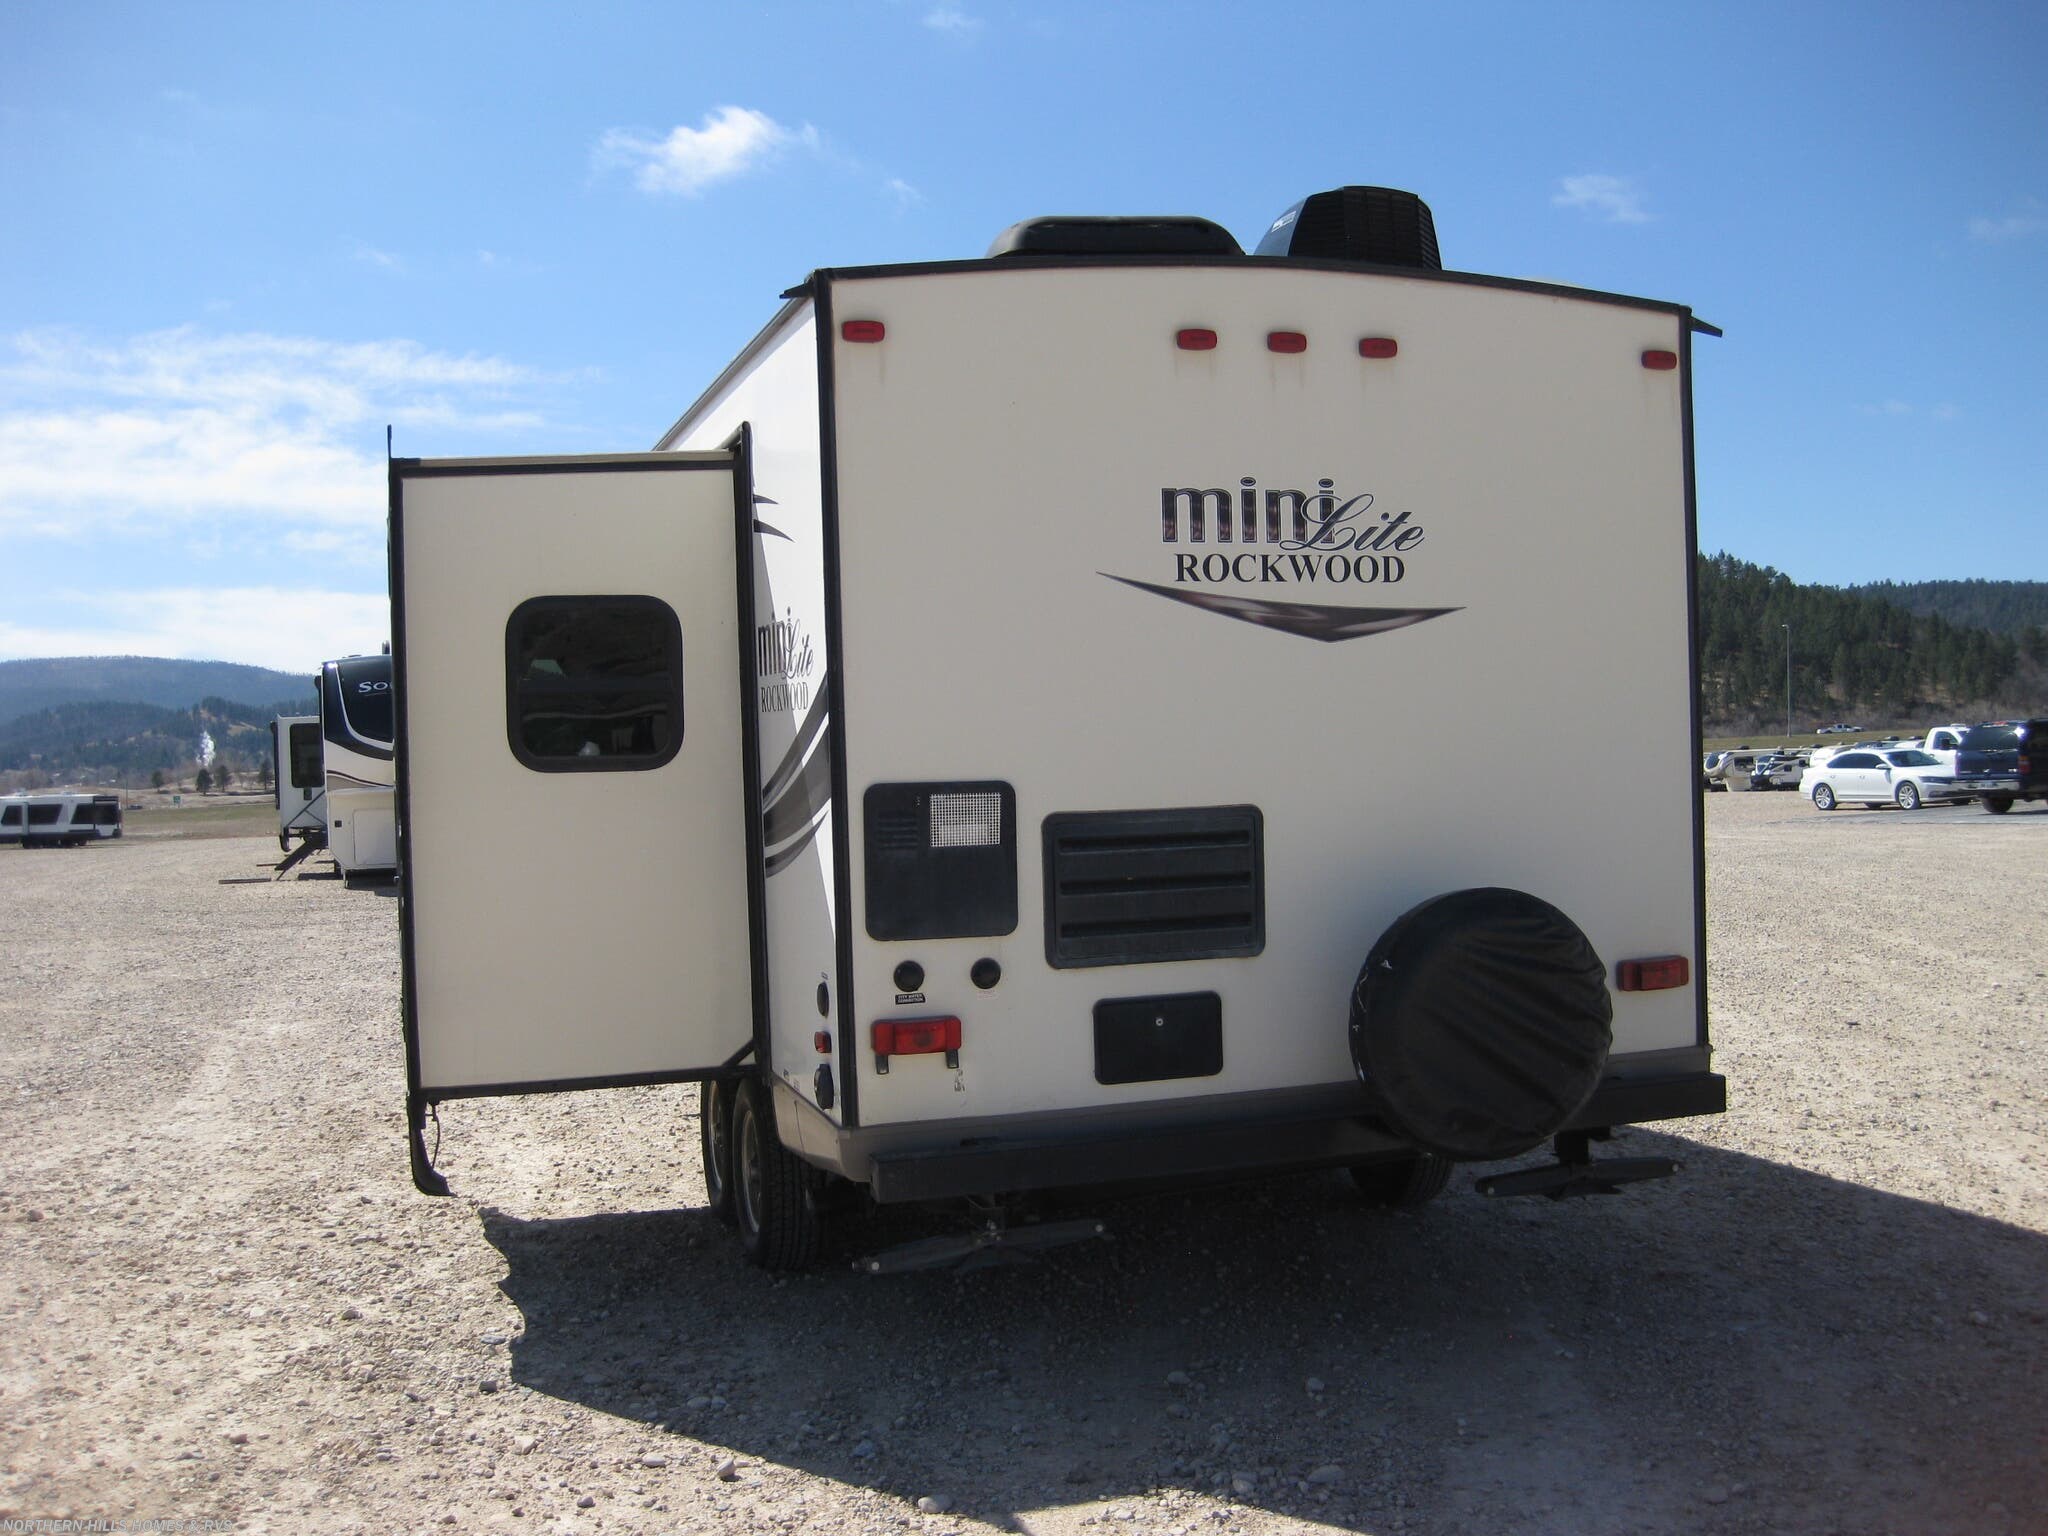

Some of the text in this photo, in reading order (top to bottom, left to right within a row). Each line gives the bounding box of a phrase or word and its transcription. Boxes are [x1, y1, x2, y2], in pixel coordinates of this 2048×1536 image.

[1161, 476, 1425, 553] mini Lite
[1174, 552, 1406, 583] ROCKWOOD
[358, 681, 393, 693] SO
[761, 682, 808, 712] ROCKWOOD
